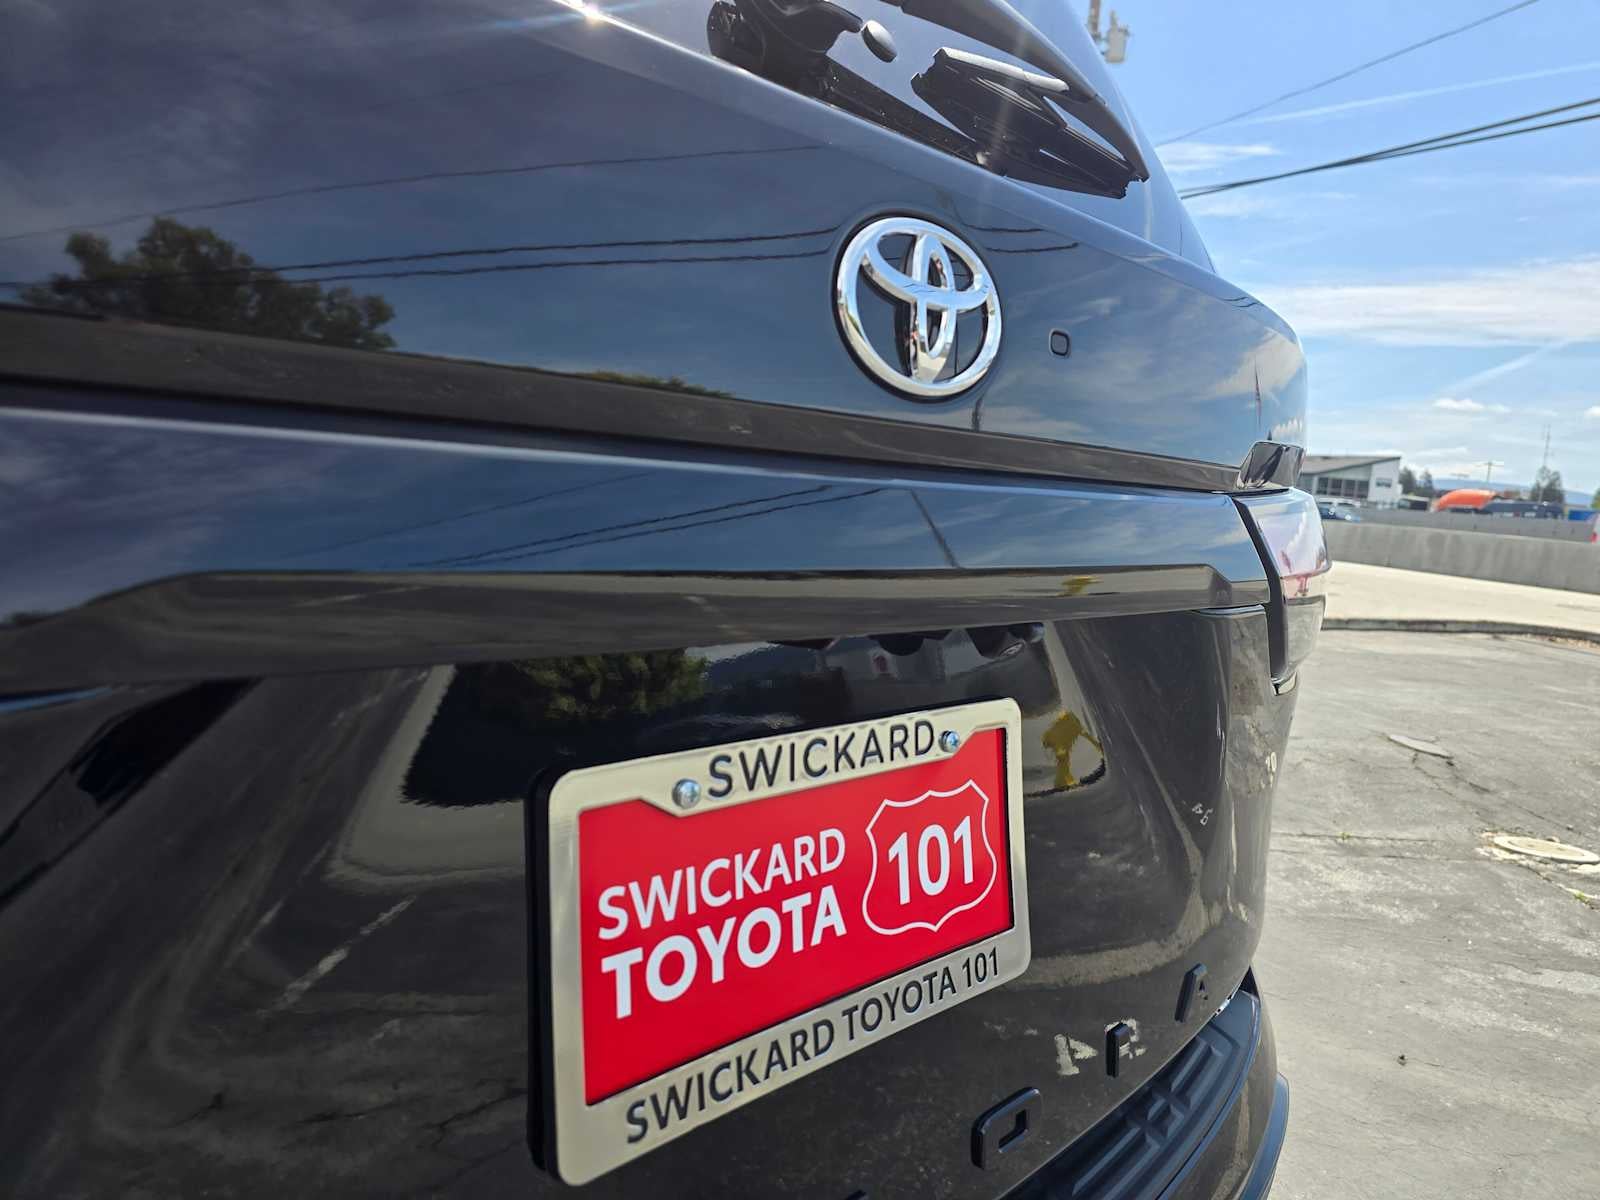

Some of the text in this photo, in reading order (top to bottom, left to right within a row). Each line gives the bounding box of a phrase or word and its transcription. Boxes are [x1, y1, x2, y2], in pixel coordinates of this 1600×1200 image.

[707, 720, 934, 798] SWICKARD
[598, 828, 846, 939] SWICKARD
[887, 816, 976, 905] 101
[601, 885, 847, 1019] TOYOTA
[626, 946, 1000, 1144] SWICKARD TOYOTA 101
